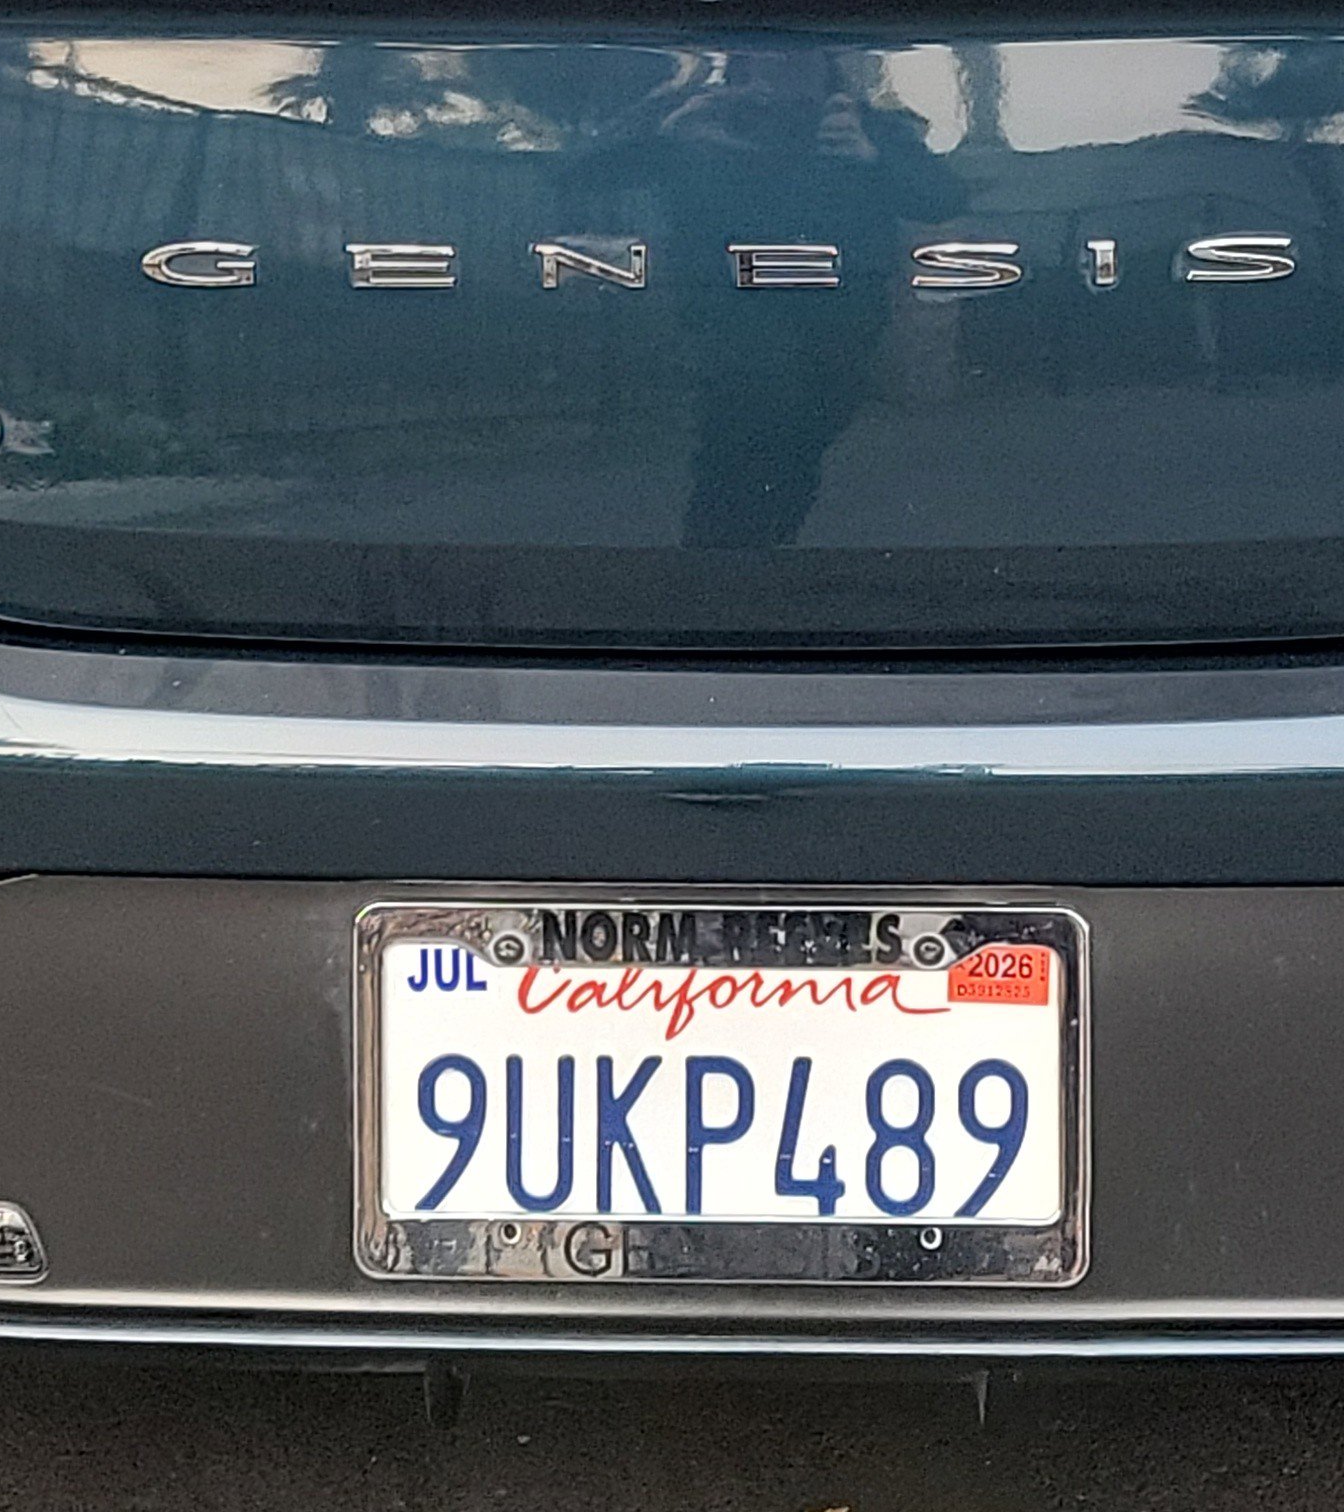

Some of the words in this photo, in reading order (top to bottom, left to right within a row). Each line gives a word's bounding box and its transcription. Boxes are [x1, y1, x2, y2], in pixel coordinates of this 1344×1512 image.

[140, 236, 1296, 289] GENESIS
[542, 910, 696, 963] NORM
[407, 948, 487, 992] JUL
[968, 952, 1033, 979] 2026
[414, 1053, 1029, 1218] 9UKP489
